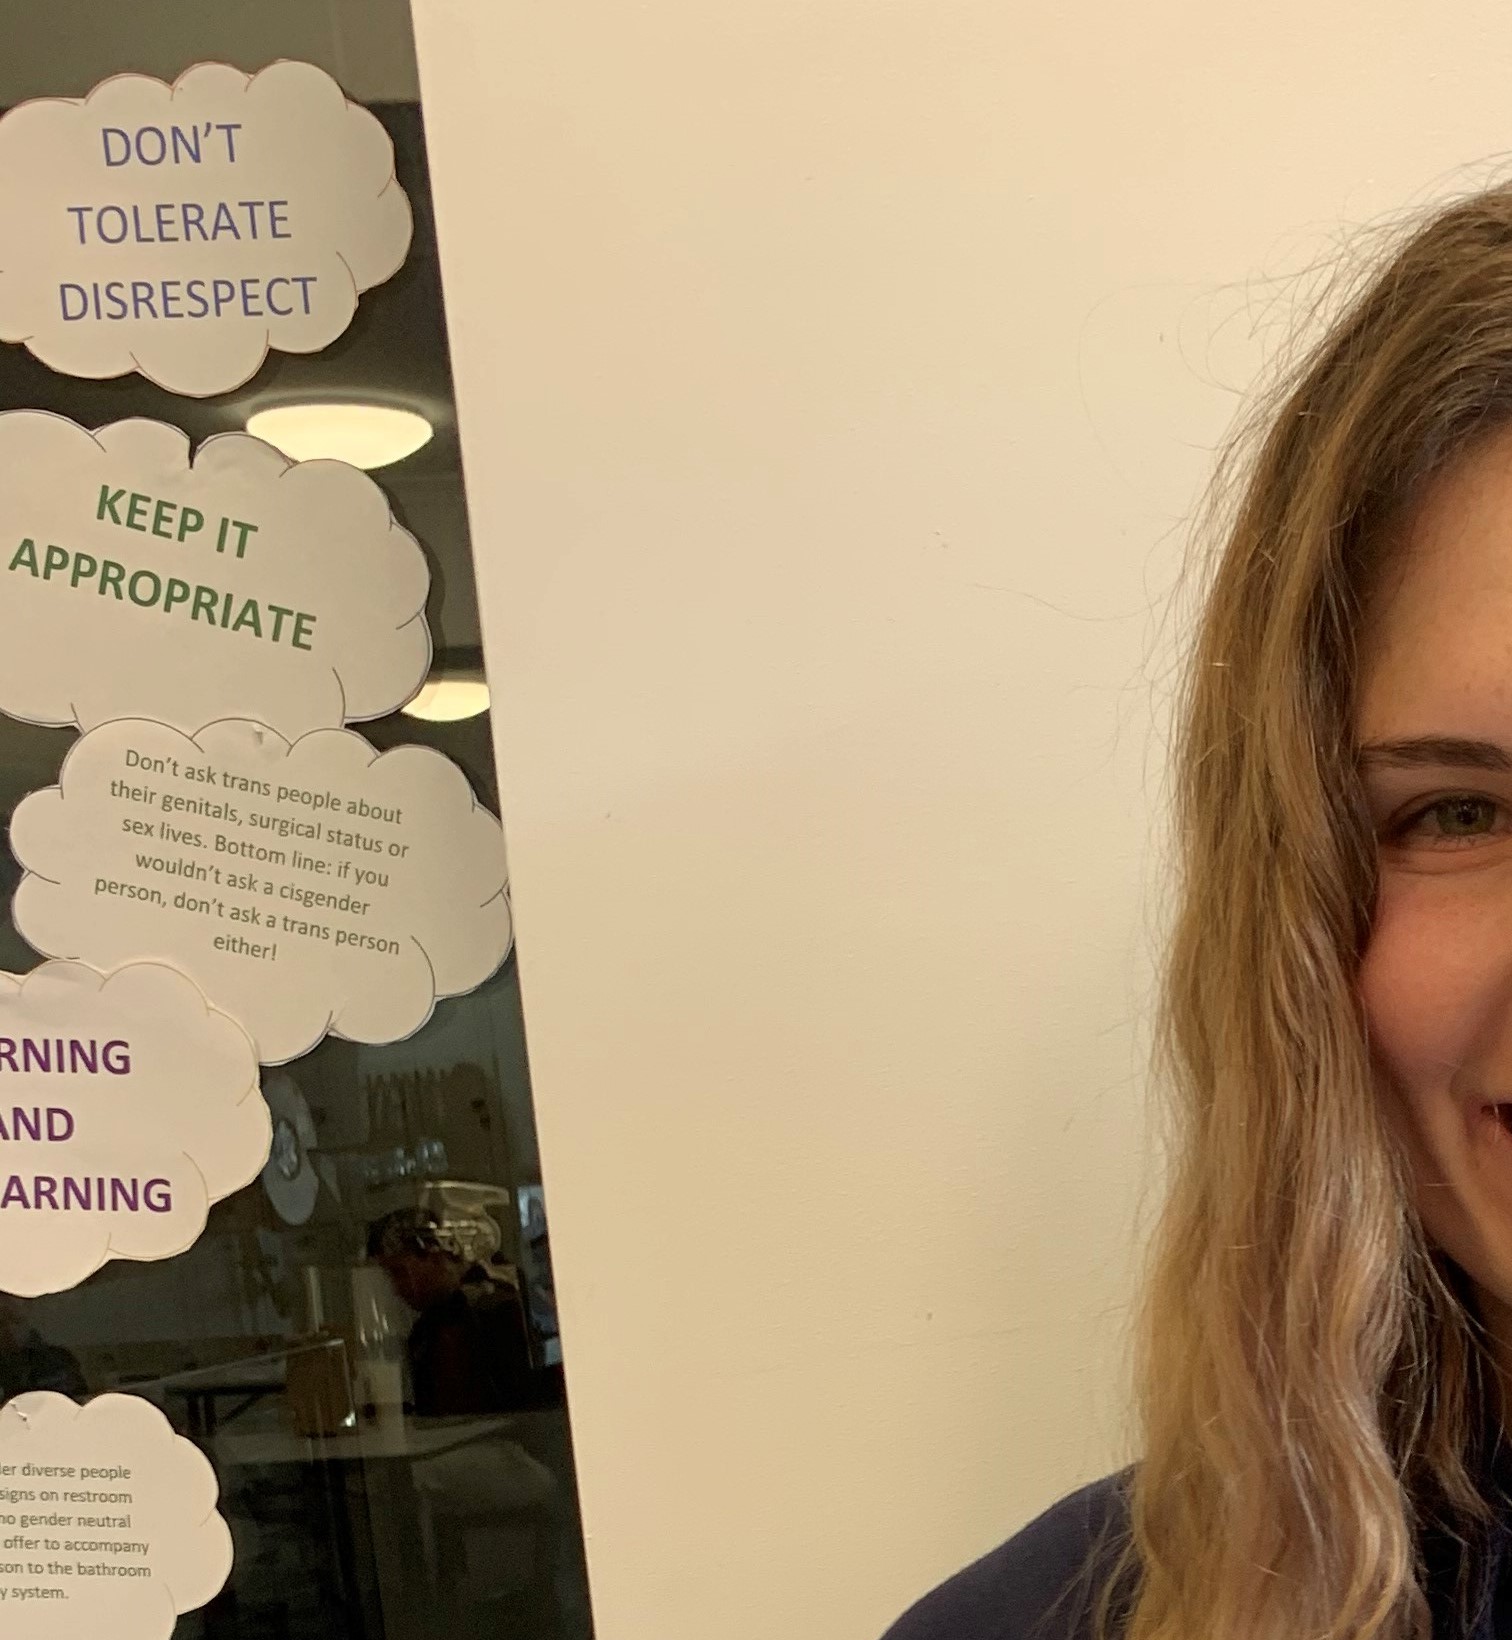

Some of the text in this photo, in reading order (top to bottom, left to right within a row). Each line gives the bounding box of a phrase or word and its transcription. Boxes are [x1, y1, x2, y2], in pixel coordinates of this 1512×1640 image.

[101, 123, 243, 168] DON’T
[67, 199, 293, 245] TOLERATE
[58, 276, 318, 323] DISRESPECT
[96, 484, 260, 560] KEEP IT
[8, 537, 318, 653] APPROPRIATE
[126, 749, 403, 825] Don’t ask trans people about
[110, 779, 410, 858] their genitals, surgical status or
[122, 818, 390, 888] sex lives. Bottom line: if you
[135, 853, 372, 917] wouldn’t ask a cisgender
[94, 877, 401, 956] person, don’t ask a trans person
[213, 933, 278, 962] either!
[0, 1174, 172, 1214] ARNING
[22, 1462, 76, 1478] diverse
[80, 1465, 132, 1481] people
[40, 1489, 59, 1502] on
[63, 1490, 133, 1504] restroom
[20, 1512, 73, 1529] gender
[77, 1514, 131, 1528] neutral
[3, 1535, 150, 1556] offer to accompany
[27, 1562, 44, 1575] to
[47, 1561, 73, 1575] the
[77, 1561, 152, 1577] bathroom
[11, 1586, 69, 1601] system.
